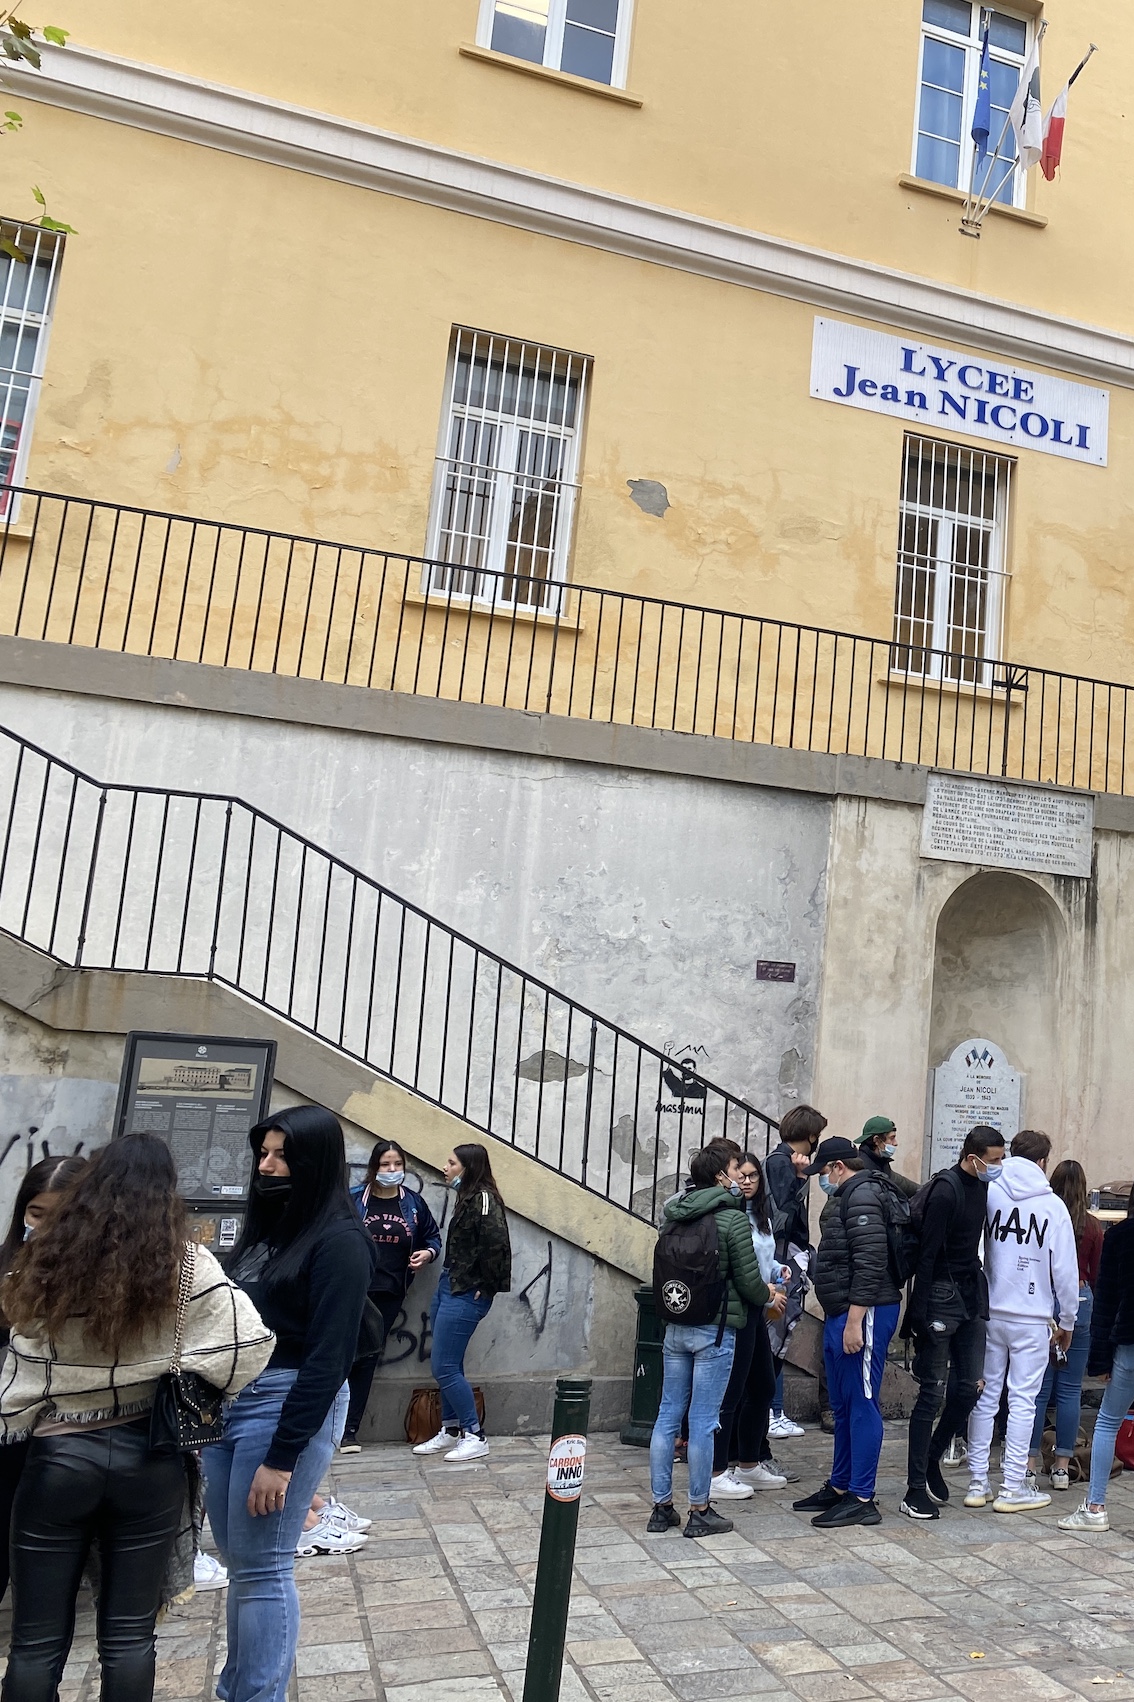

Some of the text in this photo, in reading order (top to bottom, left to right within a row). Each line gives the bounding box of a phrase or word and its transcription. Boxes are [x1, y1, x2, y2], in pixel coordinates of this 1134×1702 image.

[901, 347, 1034, 404] LYCEE
[833, 364, 1090, 450] Jean NICOLI
[665, 1283, 687, 1293] CONVERSE
